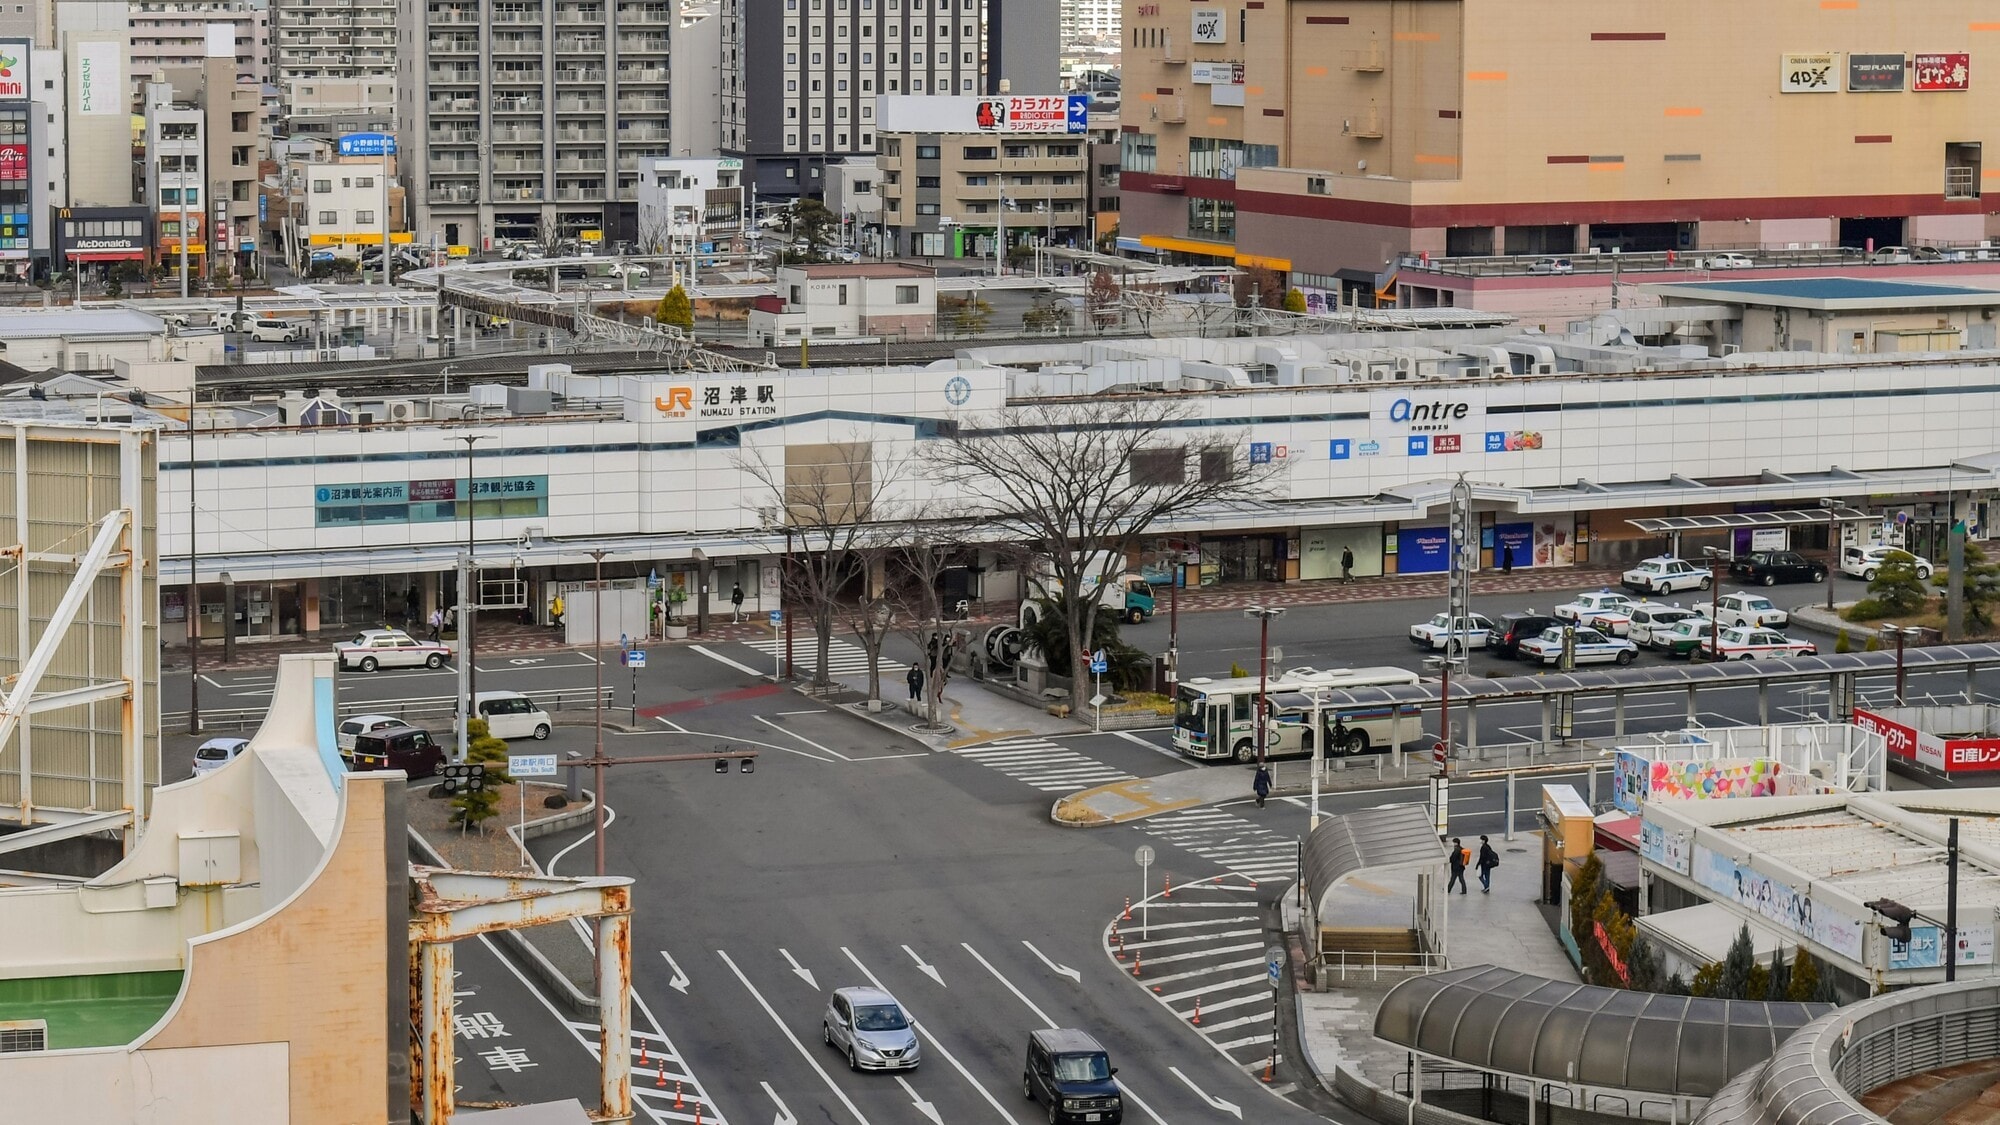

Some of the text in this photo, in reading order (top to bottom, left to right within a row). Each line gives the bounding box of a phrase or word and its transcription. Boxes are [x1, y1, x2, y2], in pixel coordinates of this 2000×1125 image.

[1197, 19, 1218, 39] 4DX
[1790, 66, 1831, 88] 4DX
[82, 58, 92, 112] エンゼルハイム
[1010, 97, 1065, 110] カラオケ
[1010, 122, 1064, 131] ラジオシティー
[1069, 121, 1086, 130] 100m
[77, 239, 131, 248] McDonald's
[655, 387, 692, 412] JR
[704, 385, 774, 405] 沼津駅
[700, 406, 776, 417] NUMAZU STATION
[1390, 398, 1469, 423] antre
[331, 487, 403, 500] 沼津観光案内所
[468, 481, 535, 494] 沼津観光協会
[1920, 744, 1942, 758] NISSAN
[512, 758, 554, 766] 沼津駅南口
